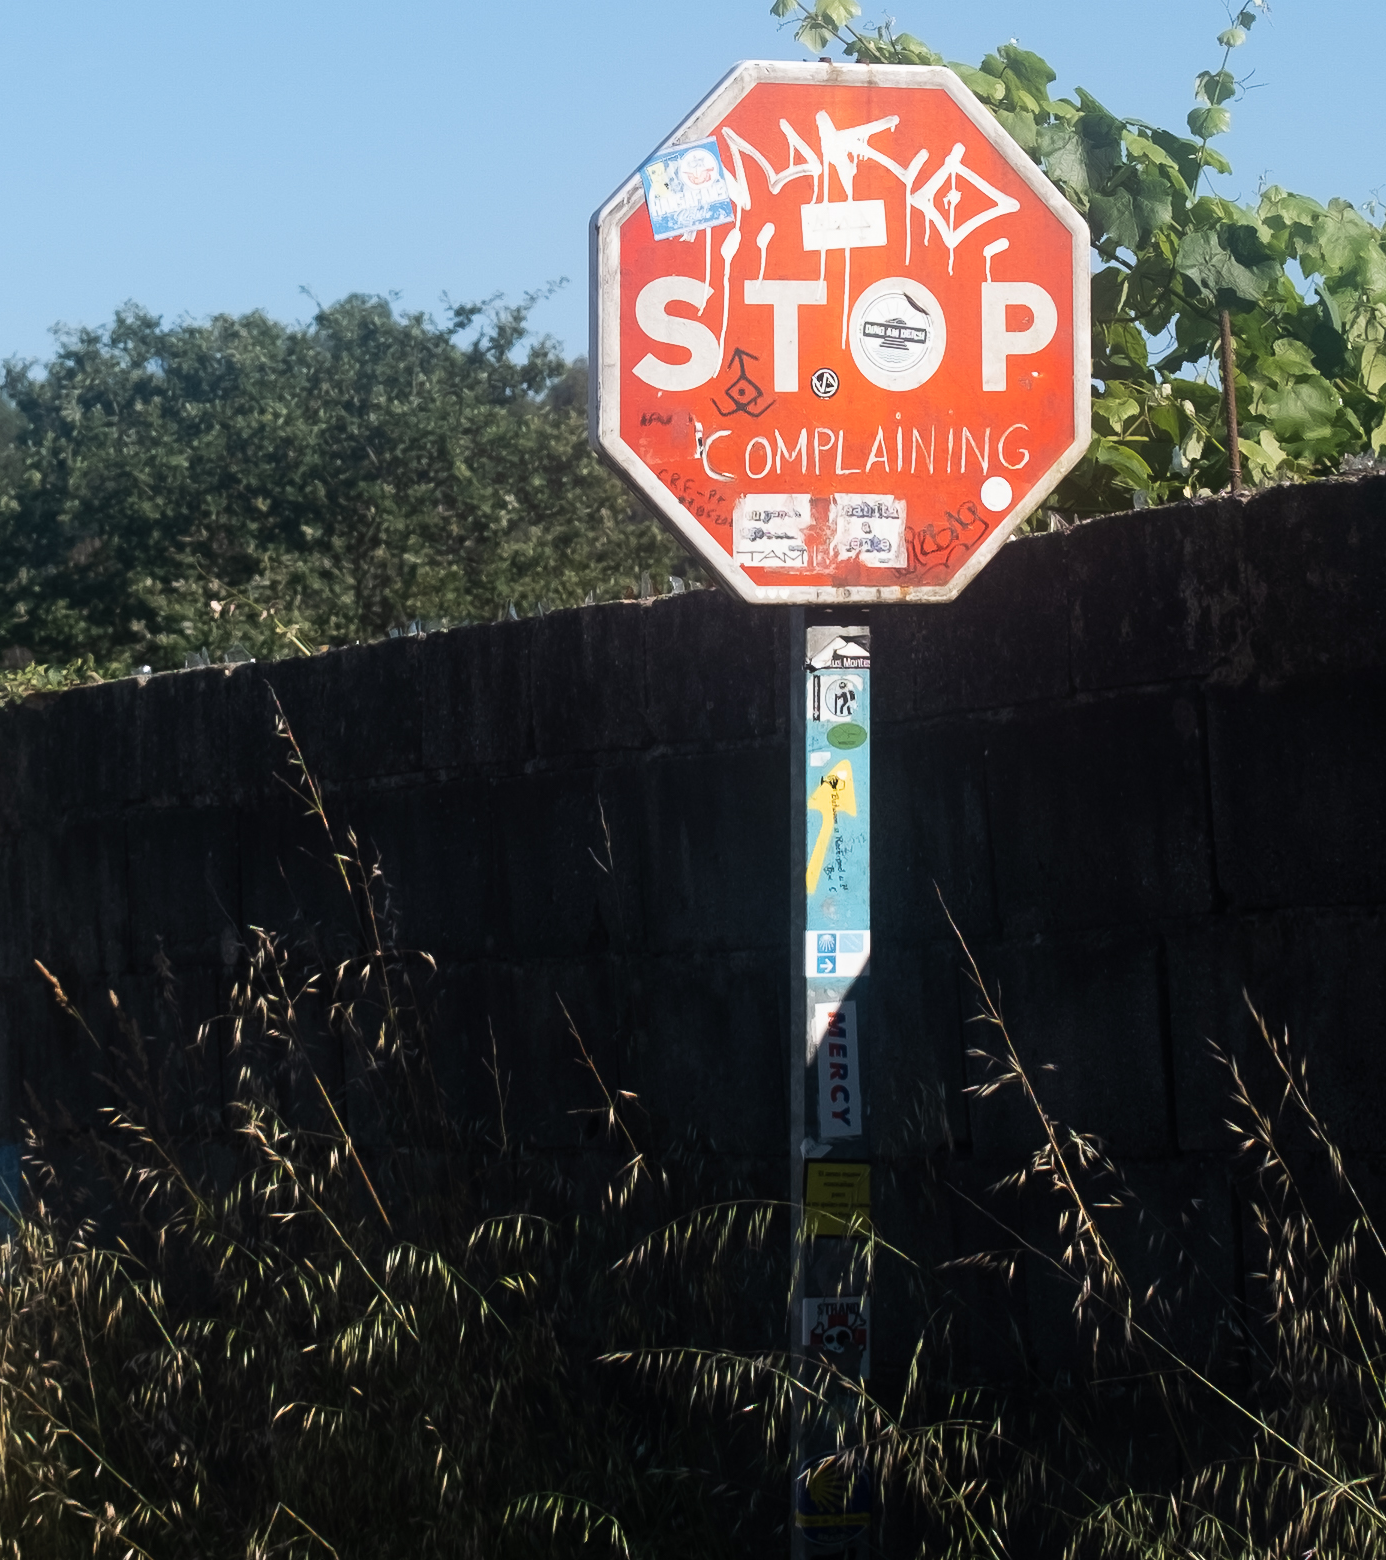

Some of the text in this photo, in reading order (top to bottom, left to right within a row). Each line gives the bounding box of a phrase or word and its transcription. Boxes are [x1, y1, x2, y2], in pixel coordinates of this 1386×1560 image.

[632, 275, 1058, 393] STOP
[886, 327, 900, 338] AM
[828, 1011, 851, 1127] MERCY
